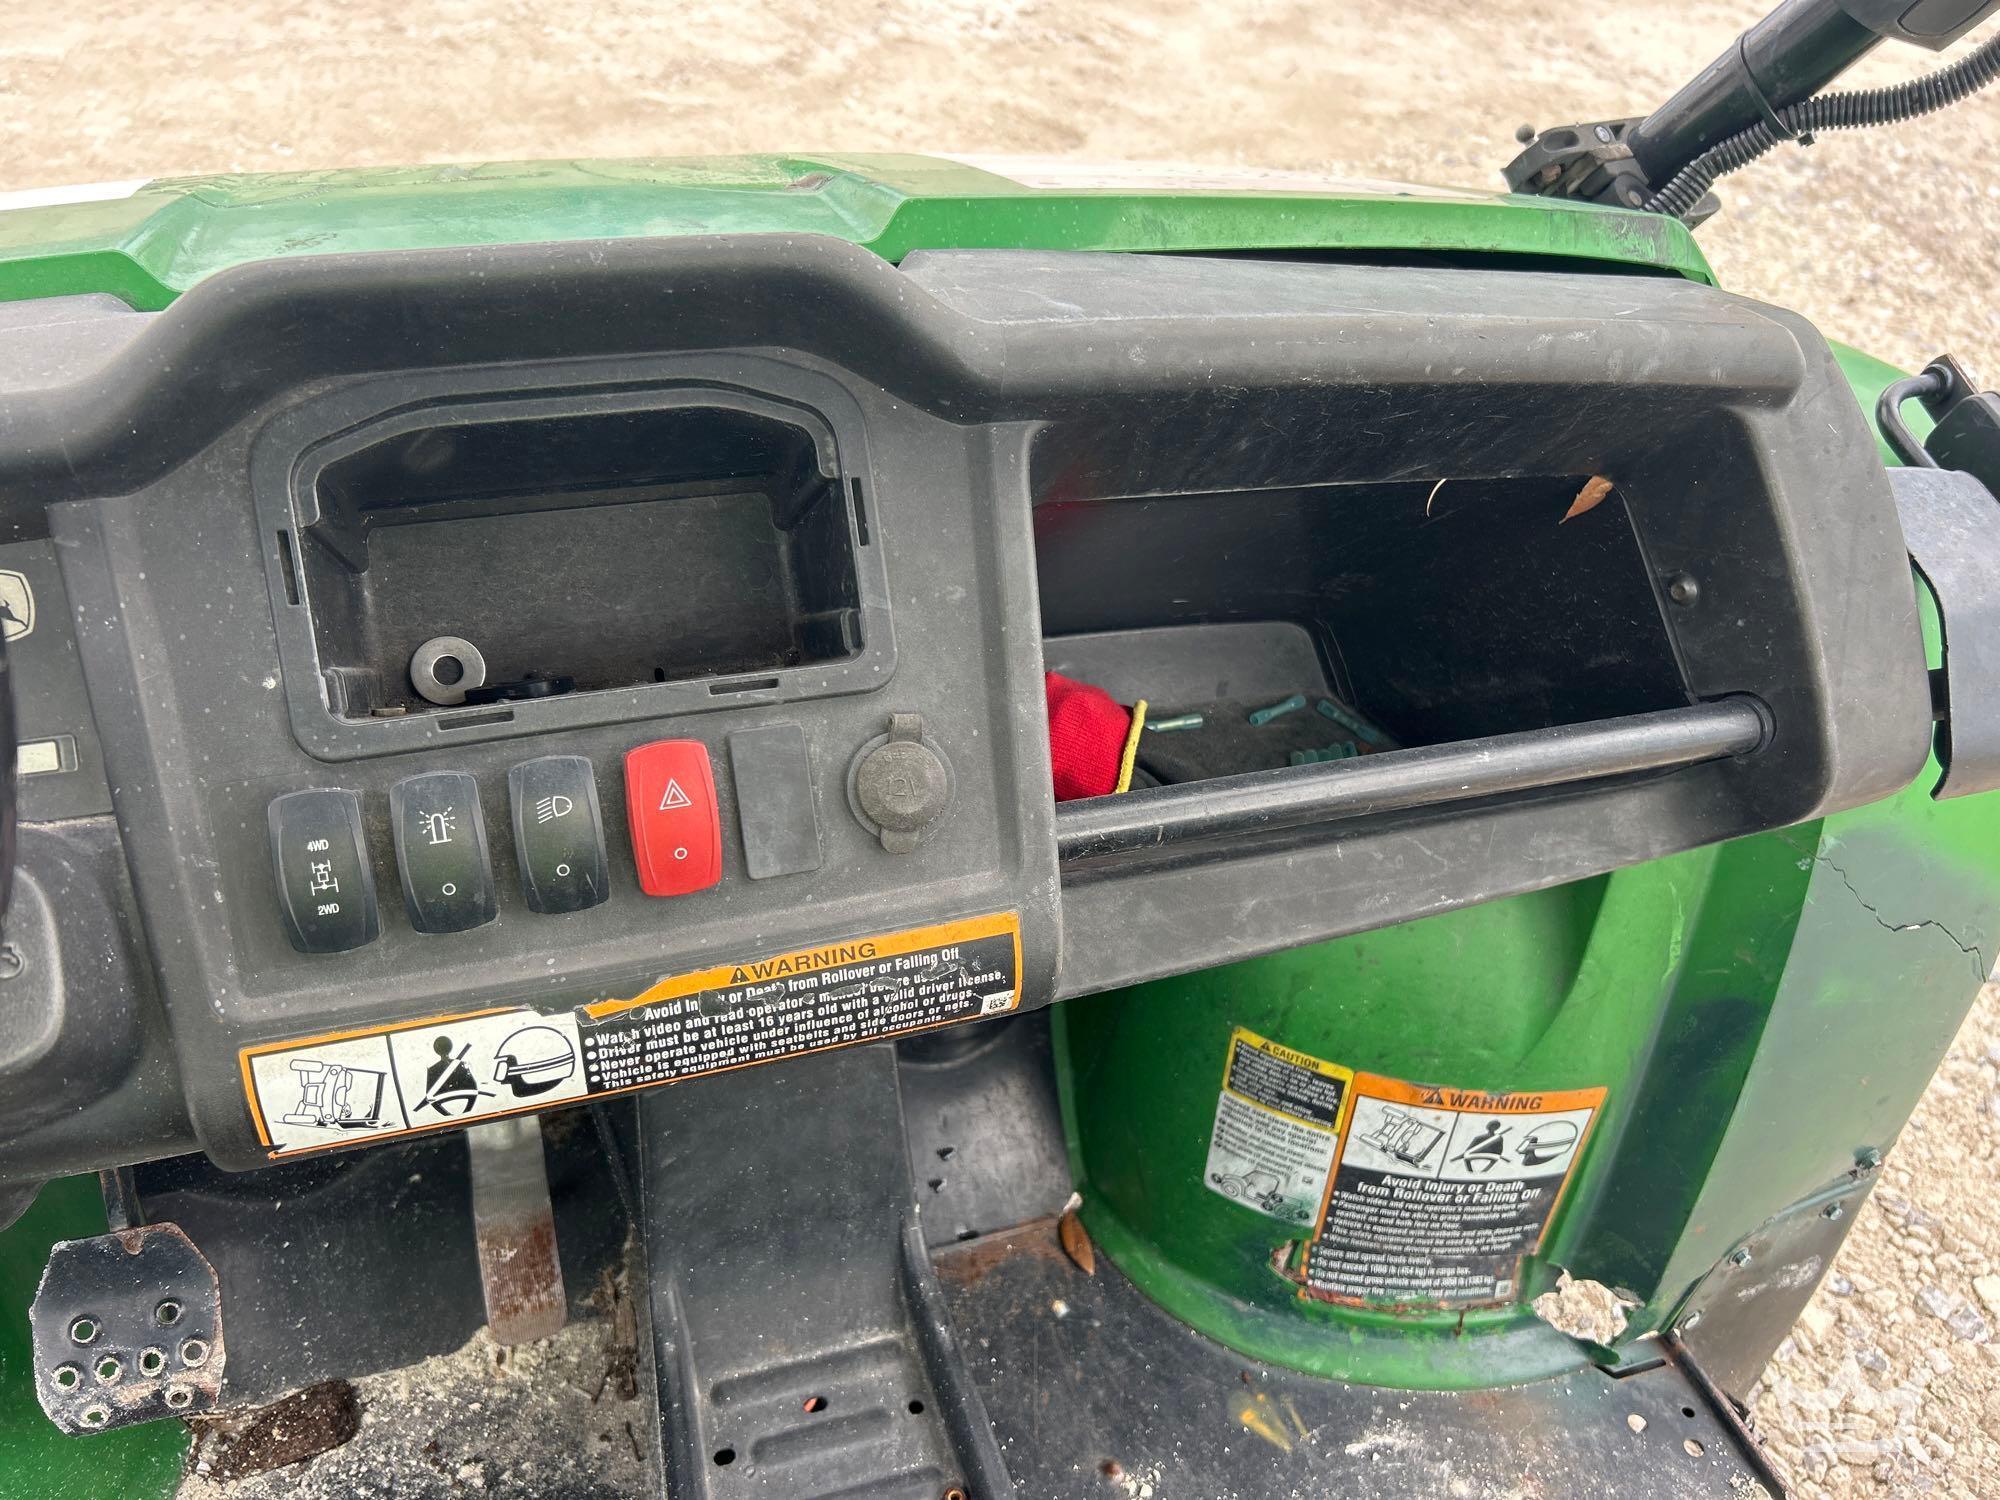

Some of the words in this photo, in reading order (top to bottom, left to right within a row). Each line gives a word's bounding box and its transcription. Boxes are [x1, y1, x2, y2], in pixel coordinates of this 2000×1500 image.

[307, 839, 329, 852] 4WD
[317, 903, 340, 916] 2WD
[751, 943, 876, 979] WARNING
[643, 1001, 682, 1021] Avoid
[728, 991, 743, 1005] or
[787, 976, 819, 992] from
[821, 964, 876, 986] Rollover
[878, 962, 892, 974] or
[894, 953, 938, 971] Falling
[941, 946, 960, 962] Off
[600, 1056, 641, 1071] Never
[645, 1045, 696, 1063] operate
[700, 1034, 749, 1051] vehicle
[753, 1025, 790, 1041] under
[794, 1013, 853, 1033] influence
[857, 1008, 869, 1020] of
[873, 998, 918, 1017] alcohol
[922, 997, 936, 1007] or
[939, 989, 977, 1004] drugs.
[642, 1021, 681, 1037] video
[714, 1006, 744, 1024] read
[645, 1034, 679, 1051] must
[683, 1031, 699, 1043] be
[703, 1026, 717, 1039] at
[721, 1019, 754, 1036] least
[758, 1015, 775, 1028] 16
[778, 1009, 814, 1027] years
[819, 1002, 838, 1016] old
[841, 996, 869, 1012] with
[872, 996, 880, 1005] a
[883, 986, 915, 1003] valid
[918, 981, 955, 996] driver
[601, 1065, 653, 1081] Vehicle
[657, 1061, 670, 1070] is
[673, 1047, 735, 1067] equipped
[739, 1041, 767, 1054] with
[771, 1029, 829, 1048] seatbelts
[833, 1022, 856, 1035] and
[860, 1017, 887, 1029] side
[891, 1010, 924, 1023] doors
[928, 1007, 941, 1015] or
[944, 1000, 974, 1012] nets.
[603, 1078, 632, 1089] This
[636, 1069, 677, 1083] safety
[681, 1053, 750, 1074] equipment
[754, 1046, 785, 1059] must
[790, 1043, 805, 1052] be
[809, 1035, 838, 1048] used
[843, 1032, 857, 1041] by
[861, 1027, 878, 1037] all
[881, 1015, 945, 1032] occupants.
[1272, 1046, 1319, 1070] CAUTION
[1450, 1092, 1542, 1111] WARNING
[1357, 1182, 1391, 1197] from
[1393, 1188, 1452, 1202] Rollover
[1455, 1194, 1470, 1204] or
[1473, 1192, 1518, 1204] Falling
[1521, 1188, 1542, 1200] Off
[1381, 1175, 1422, 1189] Avoid
[1424, 1181, 1465, 1194] Injury
[1468, 1184, 1483, 1192] or
[1485, 1181, 1525, 1193] Death
